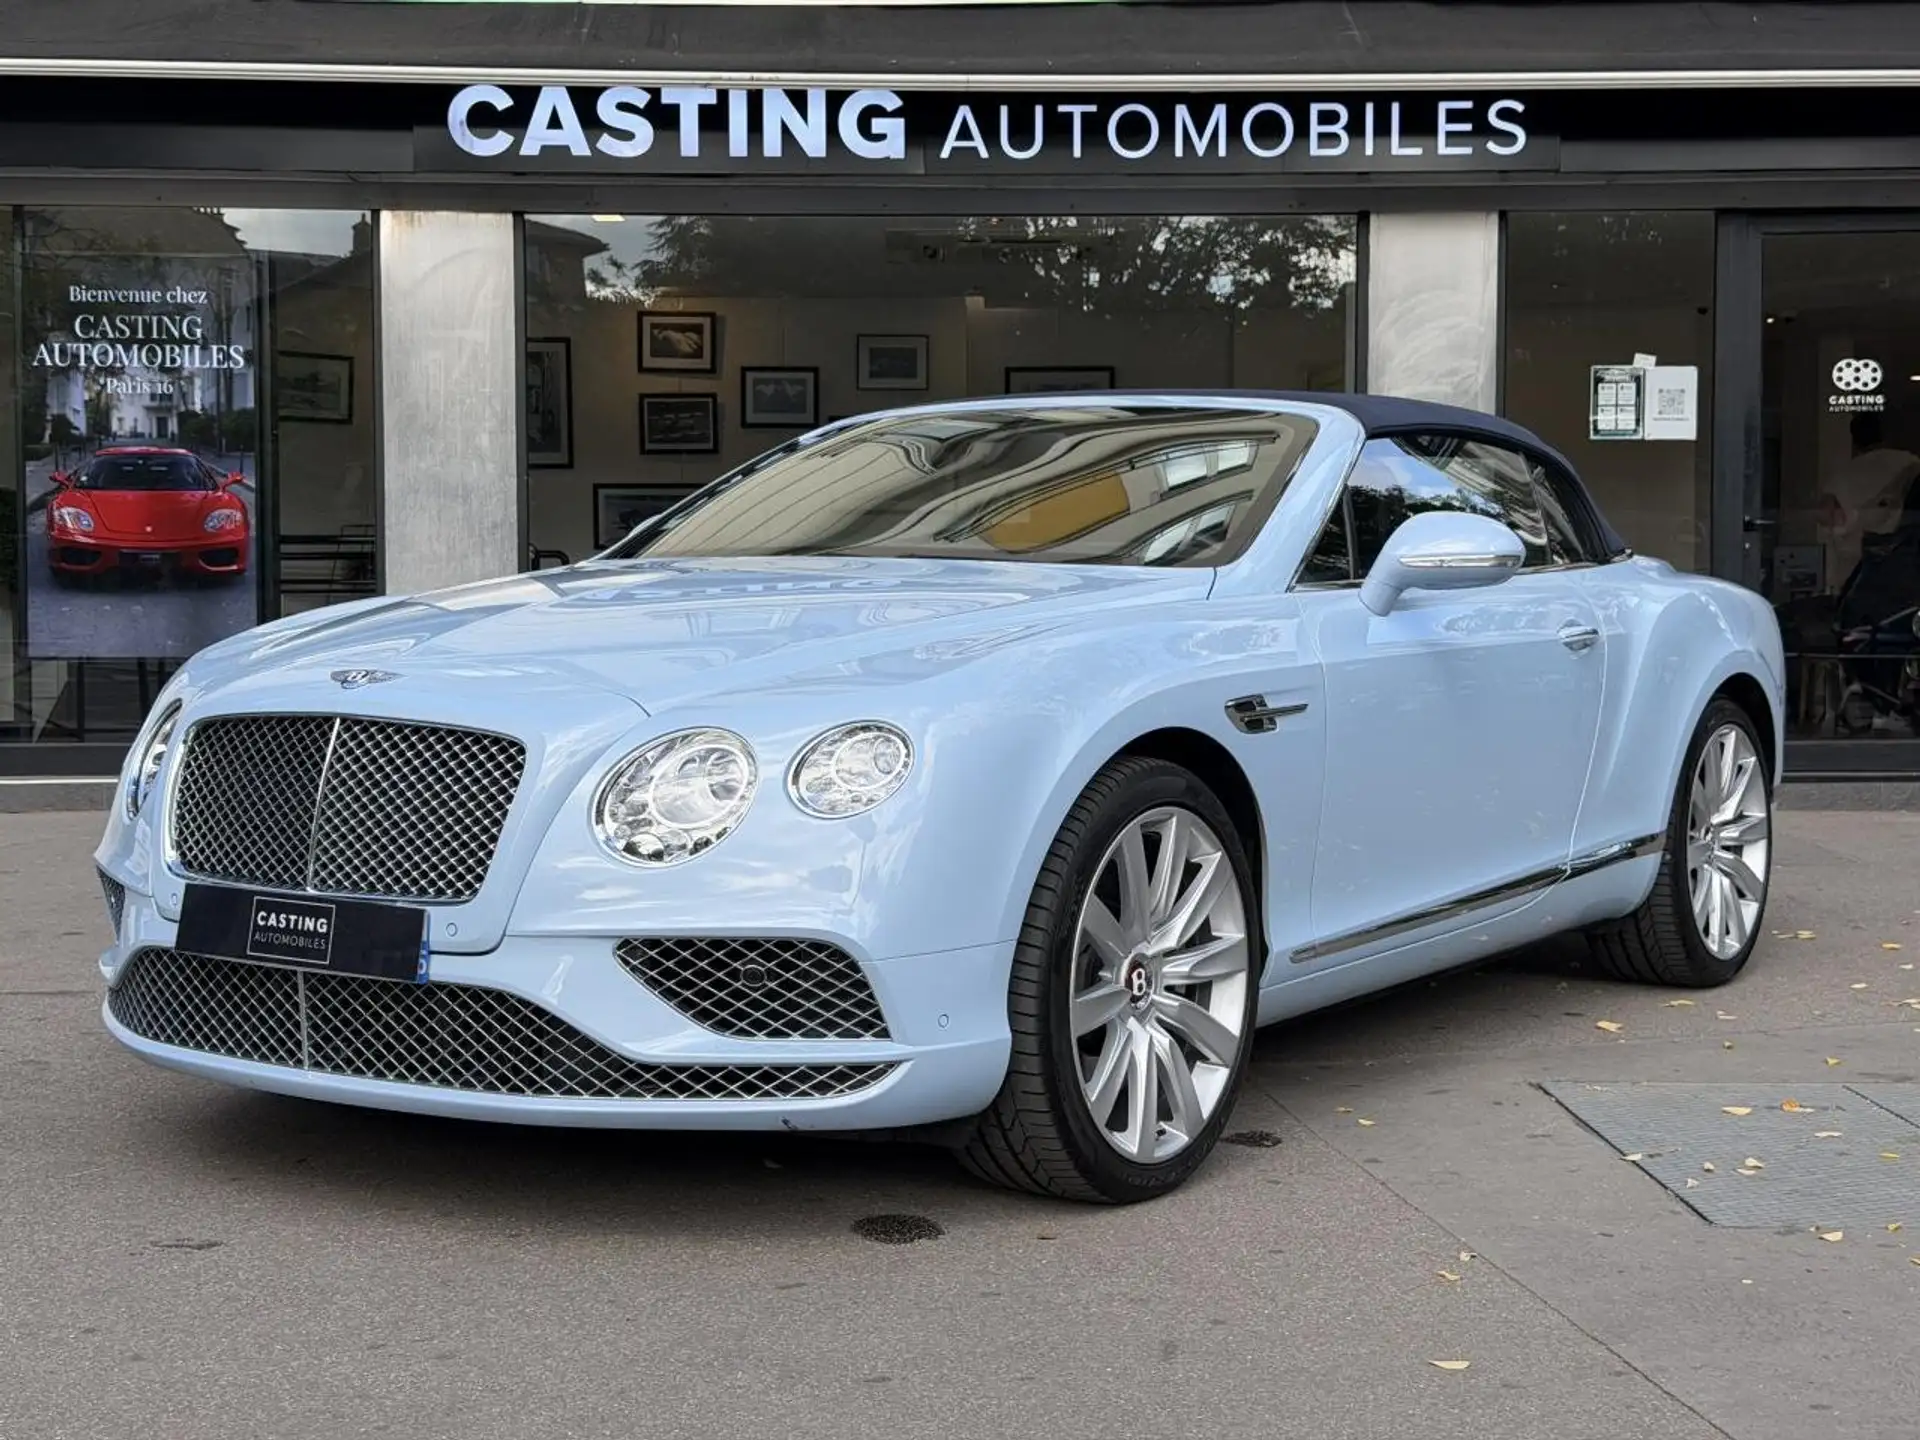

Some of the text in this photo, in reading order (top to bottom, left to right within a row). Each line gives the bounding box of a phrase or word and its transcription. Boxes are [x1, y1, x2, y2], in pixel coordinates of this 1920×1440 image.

[447, 84, 1528, 160] CASTING AUTOMOBILES
[69, 285, 208, 305] Bienvenue chez
[74, 314, 203, 340] CASTING
[32, 343, 245, 369] AUTOMOBILES
[106, 377, 174, 395] Paris 16
[1828, 394, 1884, 405] CASTING
[256, 910, 328, 933] CASTING
[253, 931, 326, 950] AUTOMOBILES
[1131, 967, 1147, 996] B
